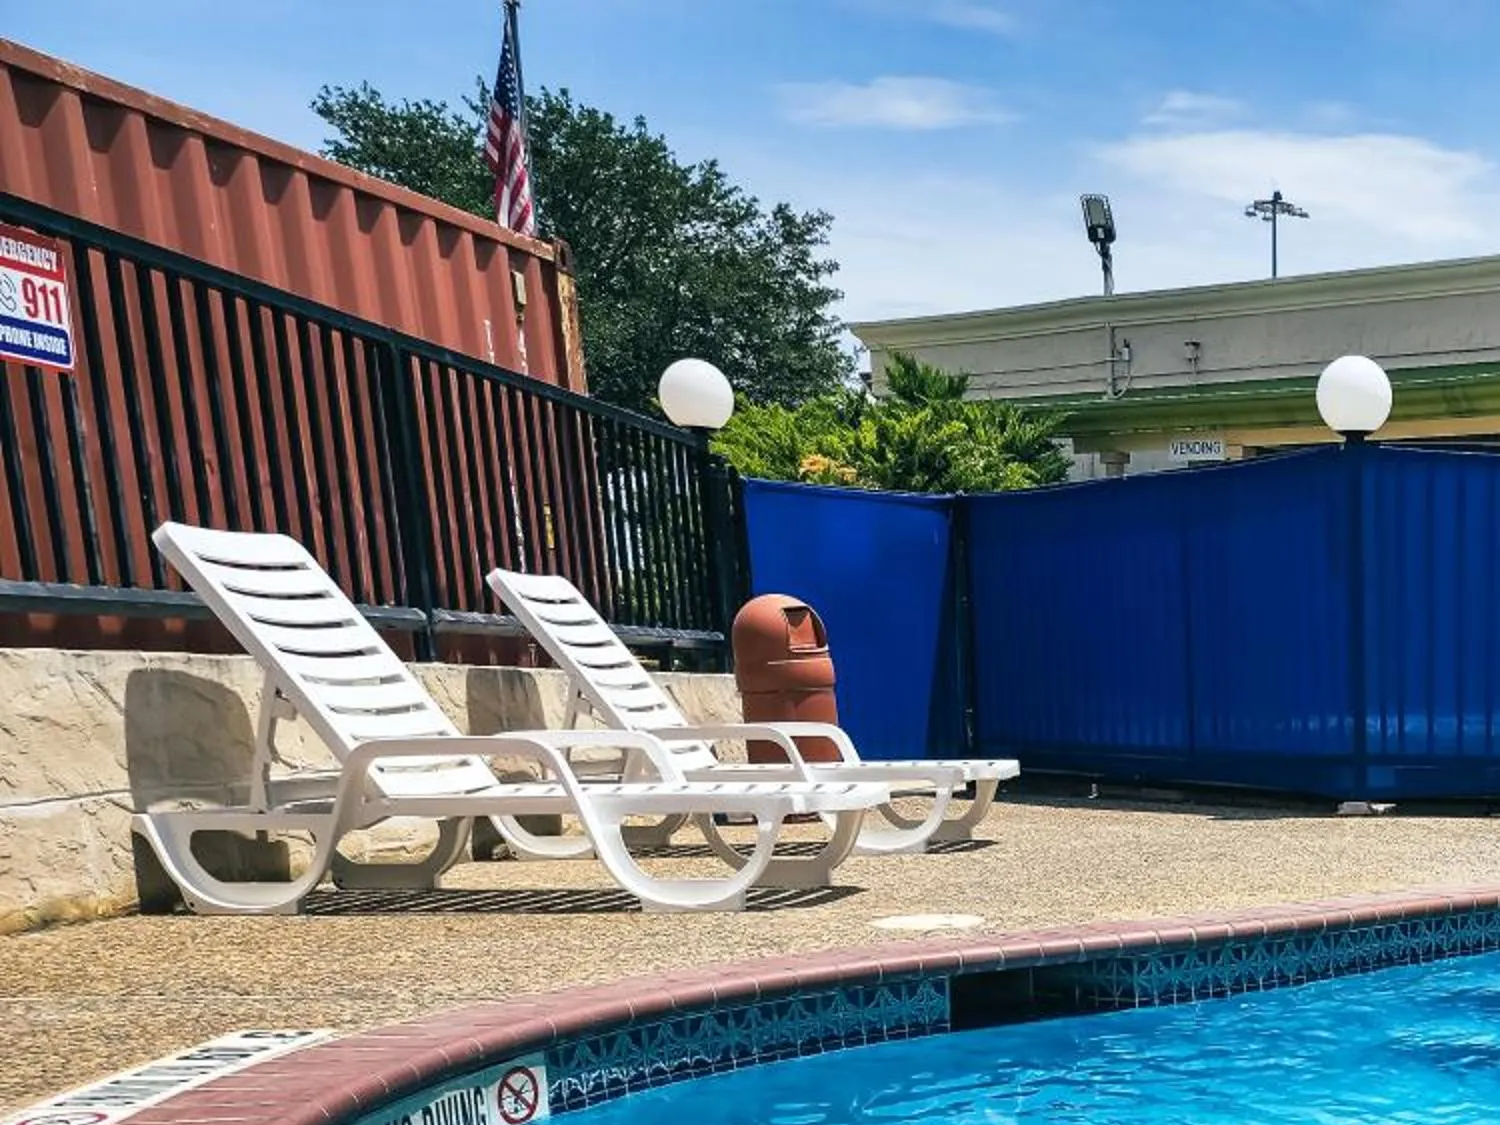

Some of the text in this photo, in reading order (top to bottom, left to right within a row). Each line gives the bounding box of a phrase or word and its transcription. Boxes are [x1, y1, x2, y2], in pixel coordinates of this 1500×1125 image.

[21, 277, 63, 325] 911
[33, 331, 67, 356] INSIDE
[1170, 441, 1221, 455] VENDING
